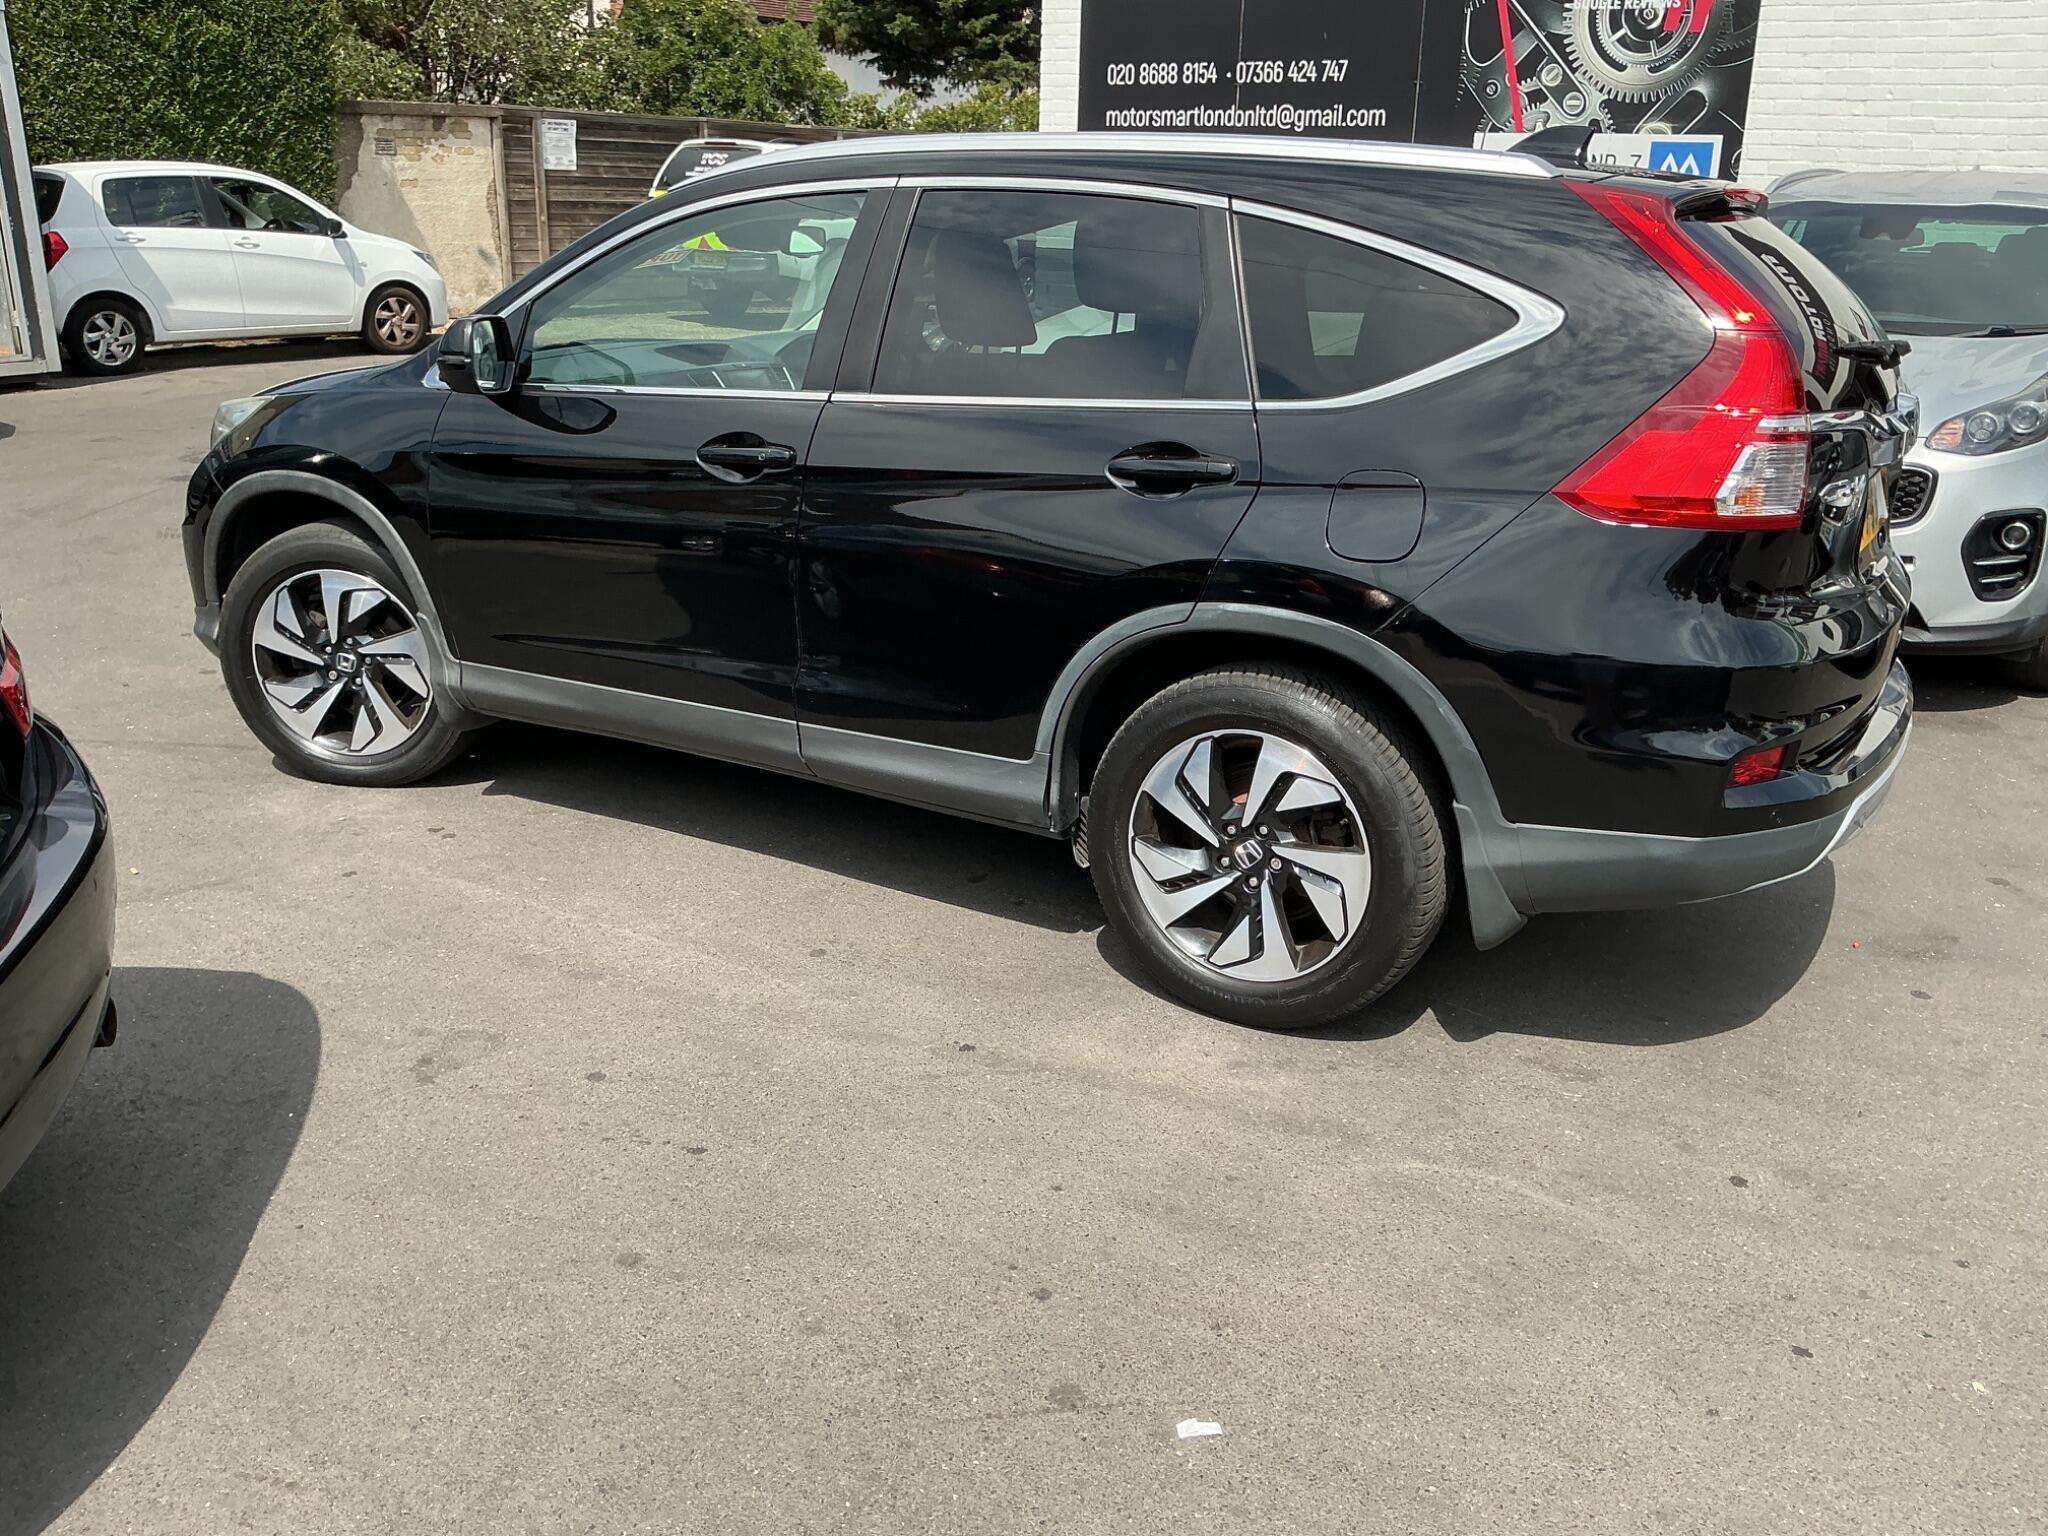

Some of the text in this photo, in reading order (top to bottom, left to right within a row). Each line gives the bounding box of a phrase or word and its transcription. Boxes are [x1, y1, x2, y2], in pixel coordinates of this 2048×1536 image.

[1106, 59, 1349, 85] 020 8688 8154 07366 424 747
[1105, 104, 1387, 132] motorsmartlondonltd@gmail.com
